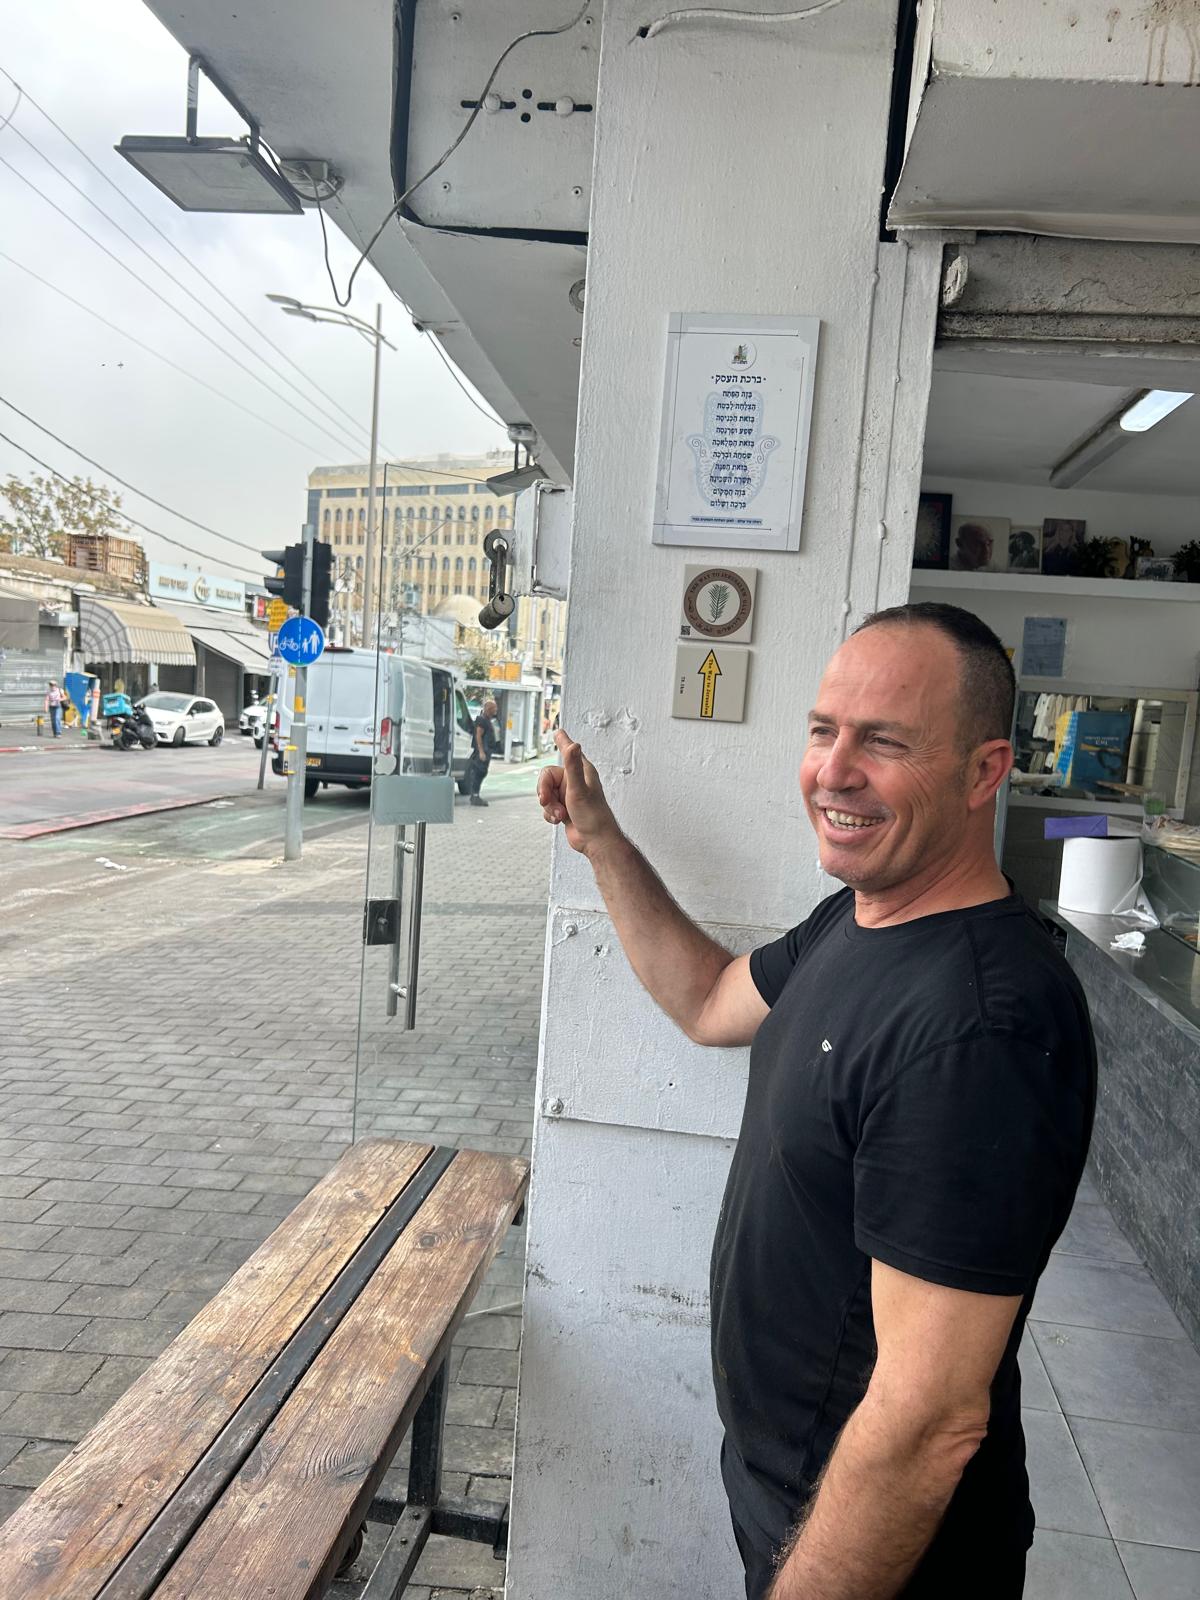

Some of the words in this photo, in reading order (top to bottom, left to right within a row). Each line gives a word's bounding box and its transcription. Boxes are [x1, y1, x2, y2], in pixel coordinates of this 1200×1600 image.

[715, 374, 738, 384] העסק
[740, 375, 762, 384] ברכת
[741, 391, 752, 399] בזה
[739, 415, 755, 423] בזאת
[739, 440, 755, 448] בזאת
[731, 464, 748, 472] בזאת
[734, 489, 746, 497] בזה
[710, 499, 729, 509] ושלום
